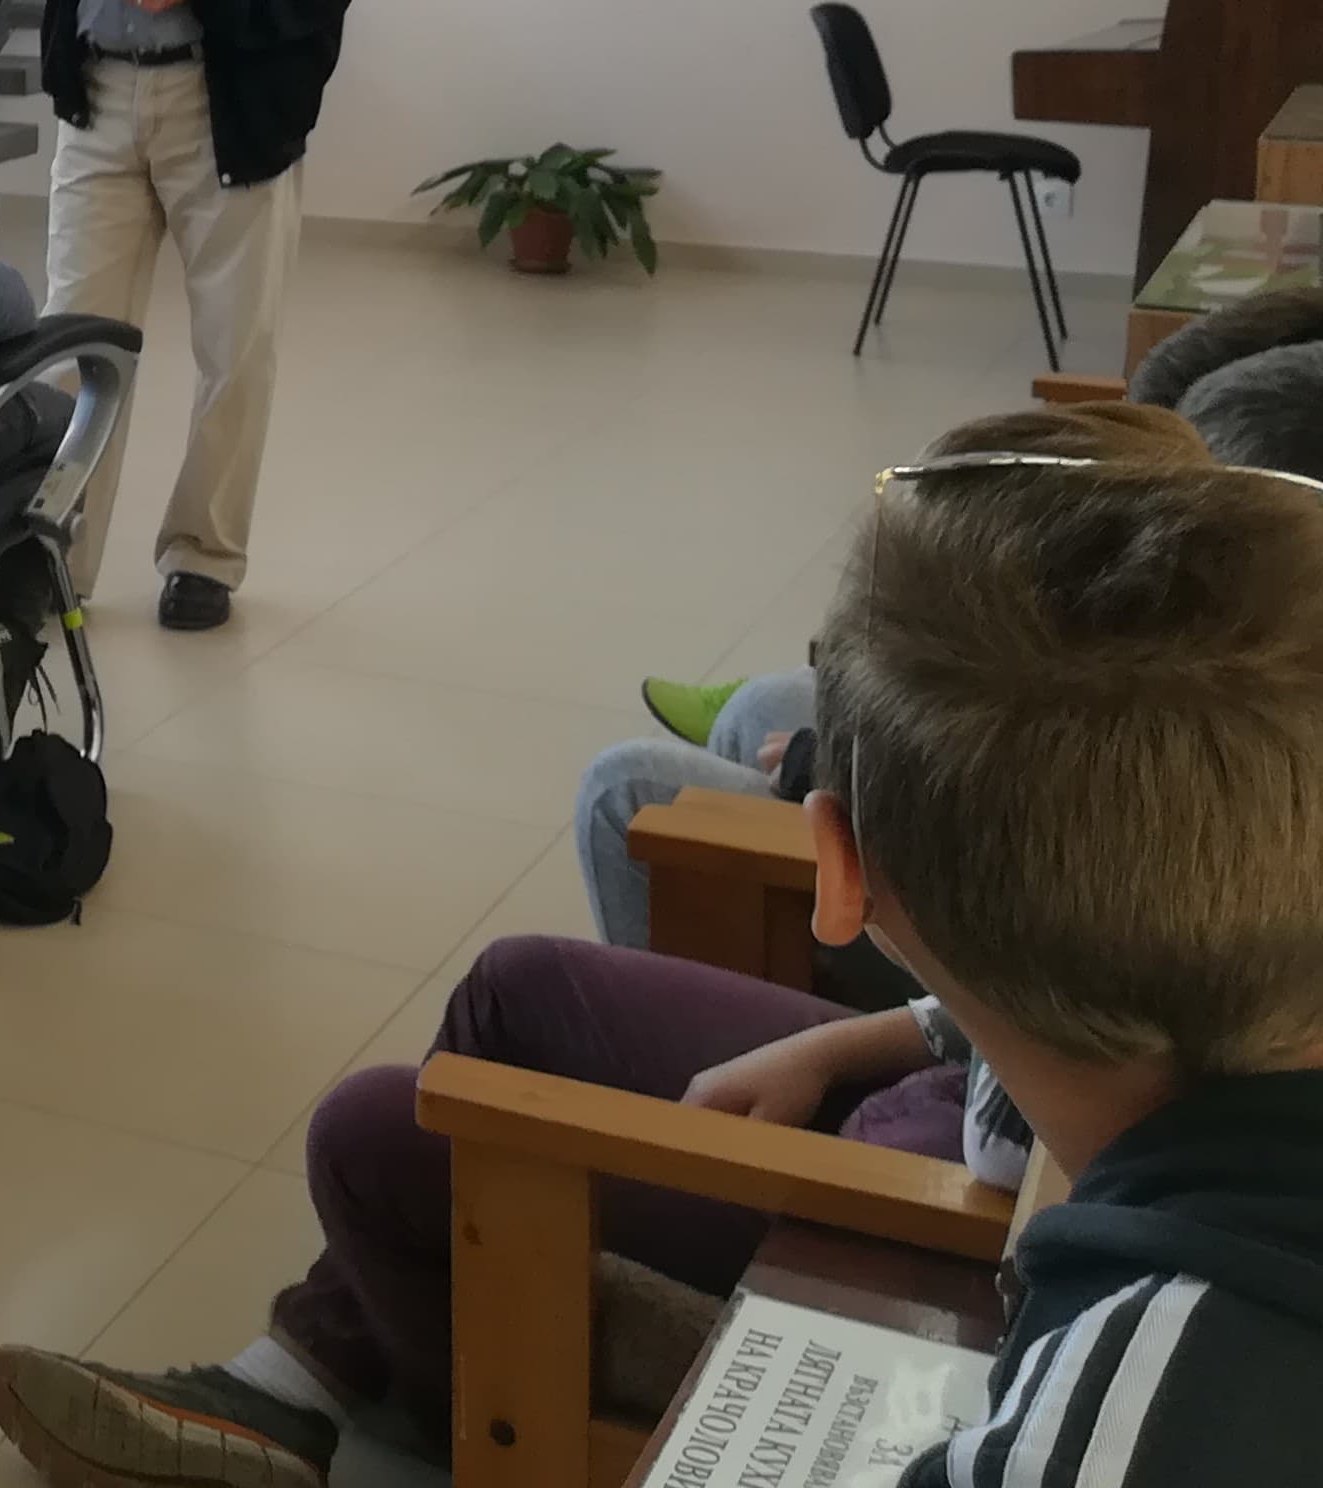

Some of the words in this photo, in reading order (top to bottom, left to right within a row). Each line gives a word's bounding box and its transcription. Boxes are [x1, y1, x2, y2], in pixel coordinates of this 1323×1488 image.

[736, 1328, 783, 1359] НА
[763, 1339, 842, 1436] ЛЯТНАТА
[868, 1437, 914, 1467] ЗА
